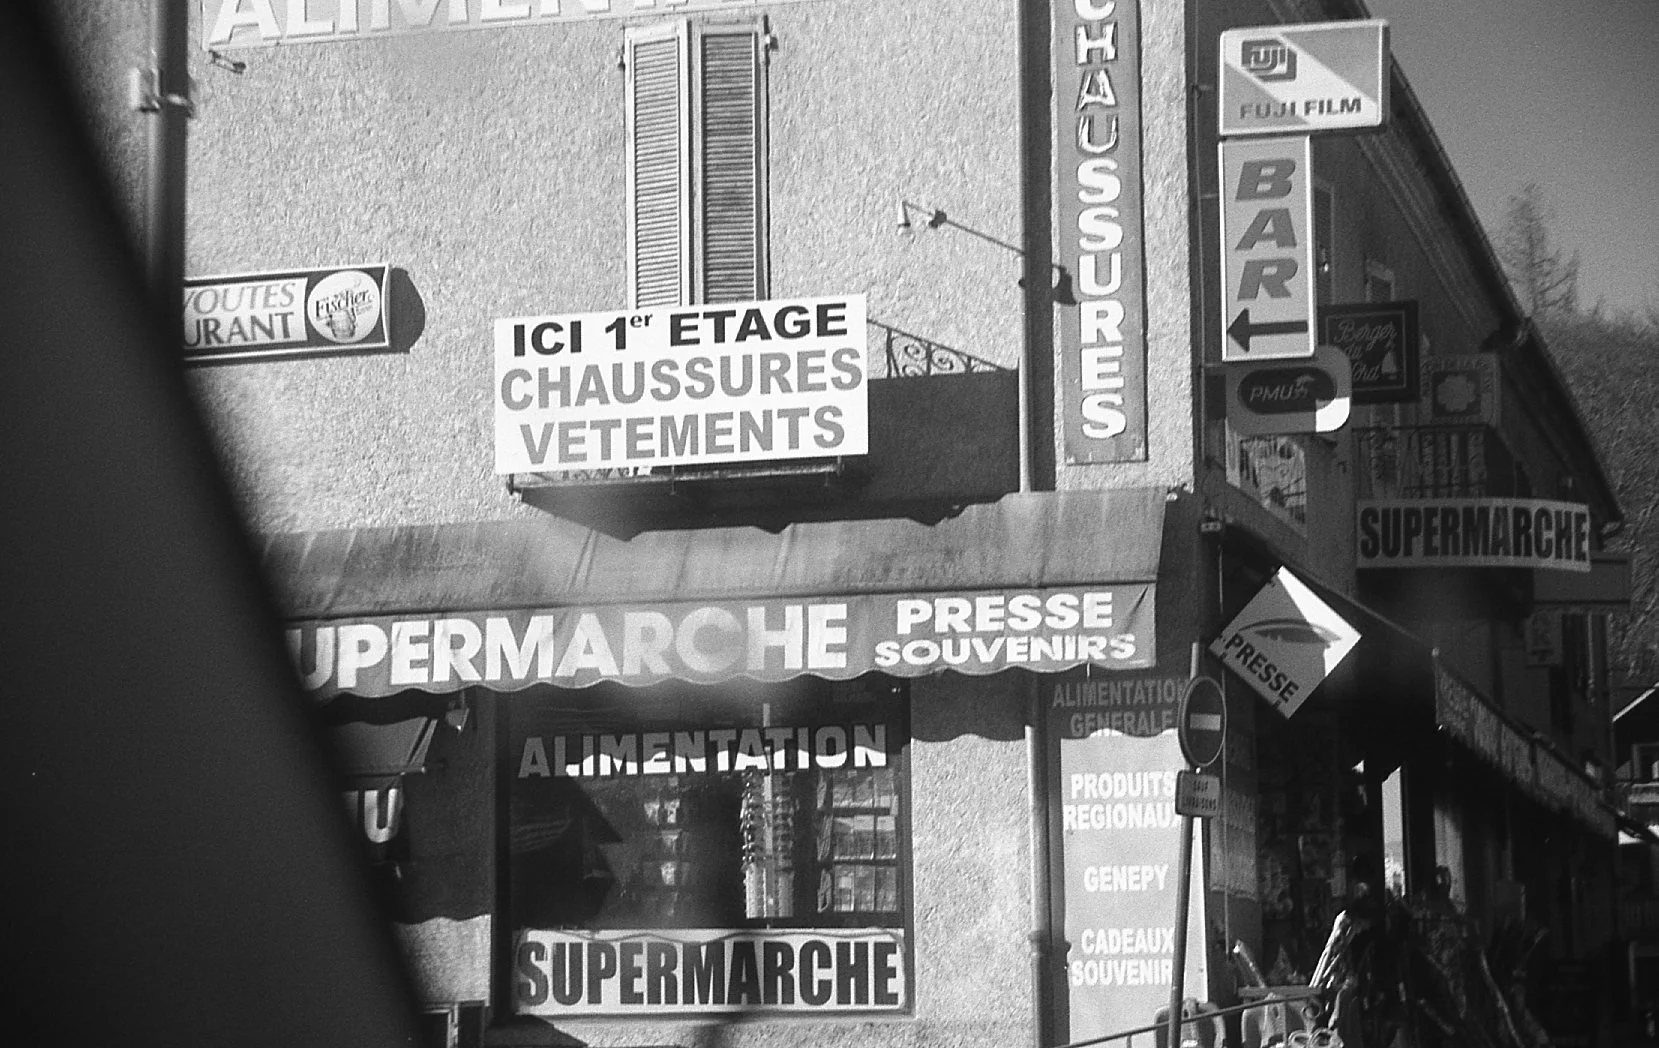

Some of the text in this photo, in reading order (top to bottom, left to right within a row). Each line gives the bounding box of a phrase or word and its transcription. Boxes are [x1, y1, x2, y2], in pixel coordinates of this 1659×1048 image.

[1239, 97, 1362, 119] FUJI FILM
[1235, 158, 1298, 301] BAR
[315, 288, 370, 320] Fischer
[513, 303, 848, 357] ICI 1er ETAGE
[1333, 319, 1398, 352] Berger
[501, 347, 863, 411] CHAUSSURES
[1249, 384, 1296, 403] PMU
[520, 405, 846, 465] VETEMENTS
[1360, 505, 1590, 561] SUPERMARCHE
[897, 592, 1113, 634] PRESSE
[874, 633, 1137, 667] SOUVENIRS
[1225, 633, 1299, 703] PRESSE
[518, 724, 887, 778] ALIMENTATION
[1070, 771, 1176, 799] PRODUITS
[1083, 864, 1169, 893] GENEPY
[1080, 926, 1176, 955] CADEAUX
[517, 940, 900, 1006] SUPERMARCHE
